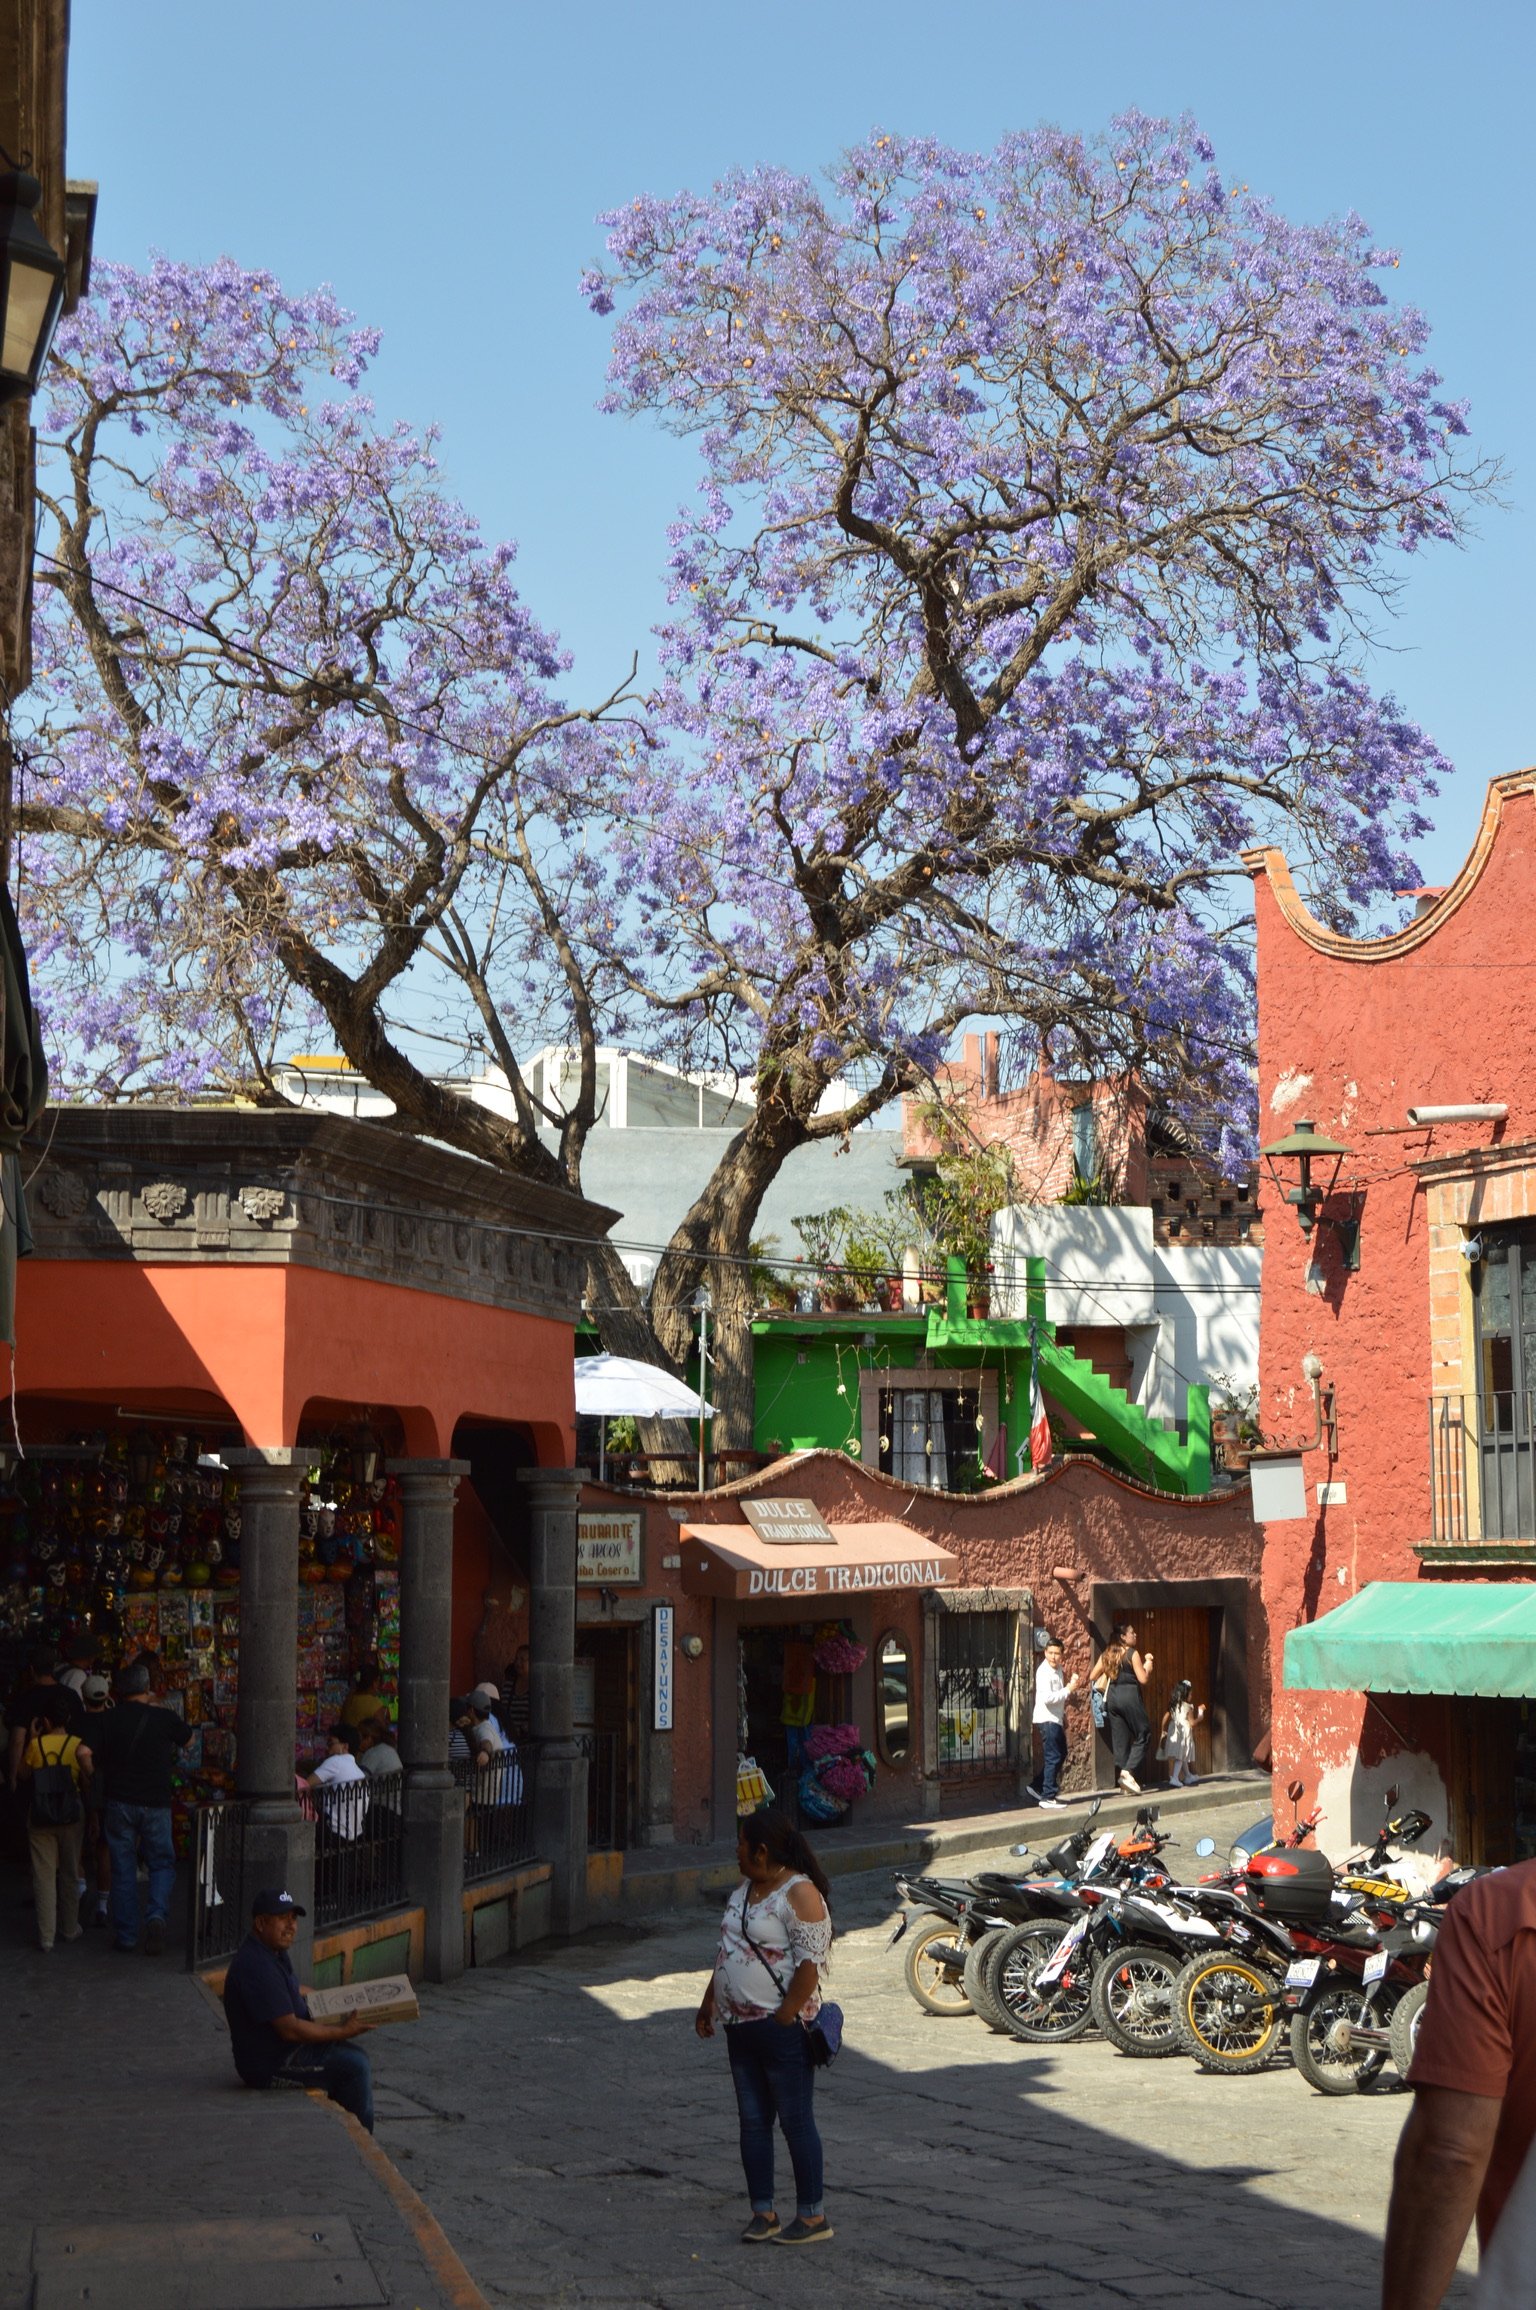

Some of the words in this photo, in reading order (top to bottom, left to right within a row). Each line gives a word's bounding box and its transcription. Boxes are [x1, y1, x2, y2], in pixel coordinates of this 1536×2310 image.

[751, 1500, 811, 1518] DULCE
[758, 1523, 831, 1538] TRADICIONAL
[749, 1568, 817, 1594] DULCE
[825, 1561, 946, 1589] TRADICIONAL
[659, 1609, 668, 1727] DESAYUNOS
